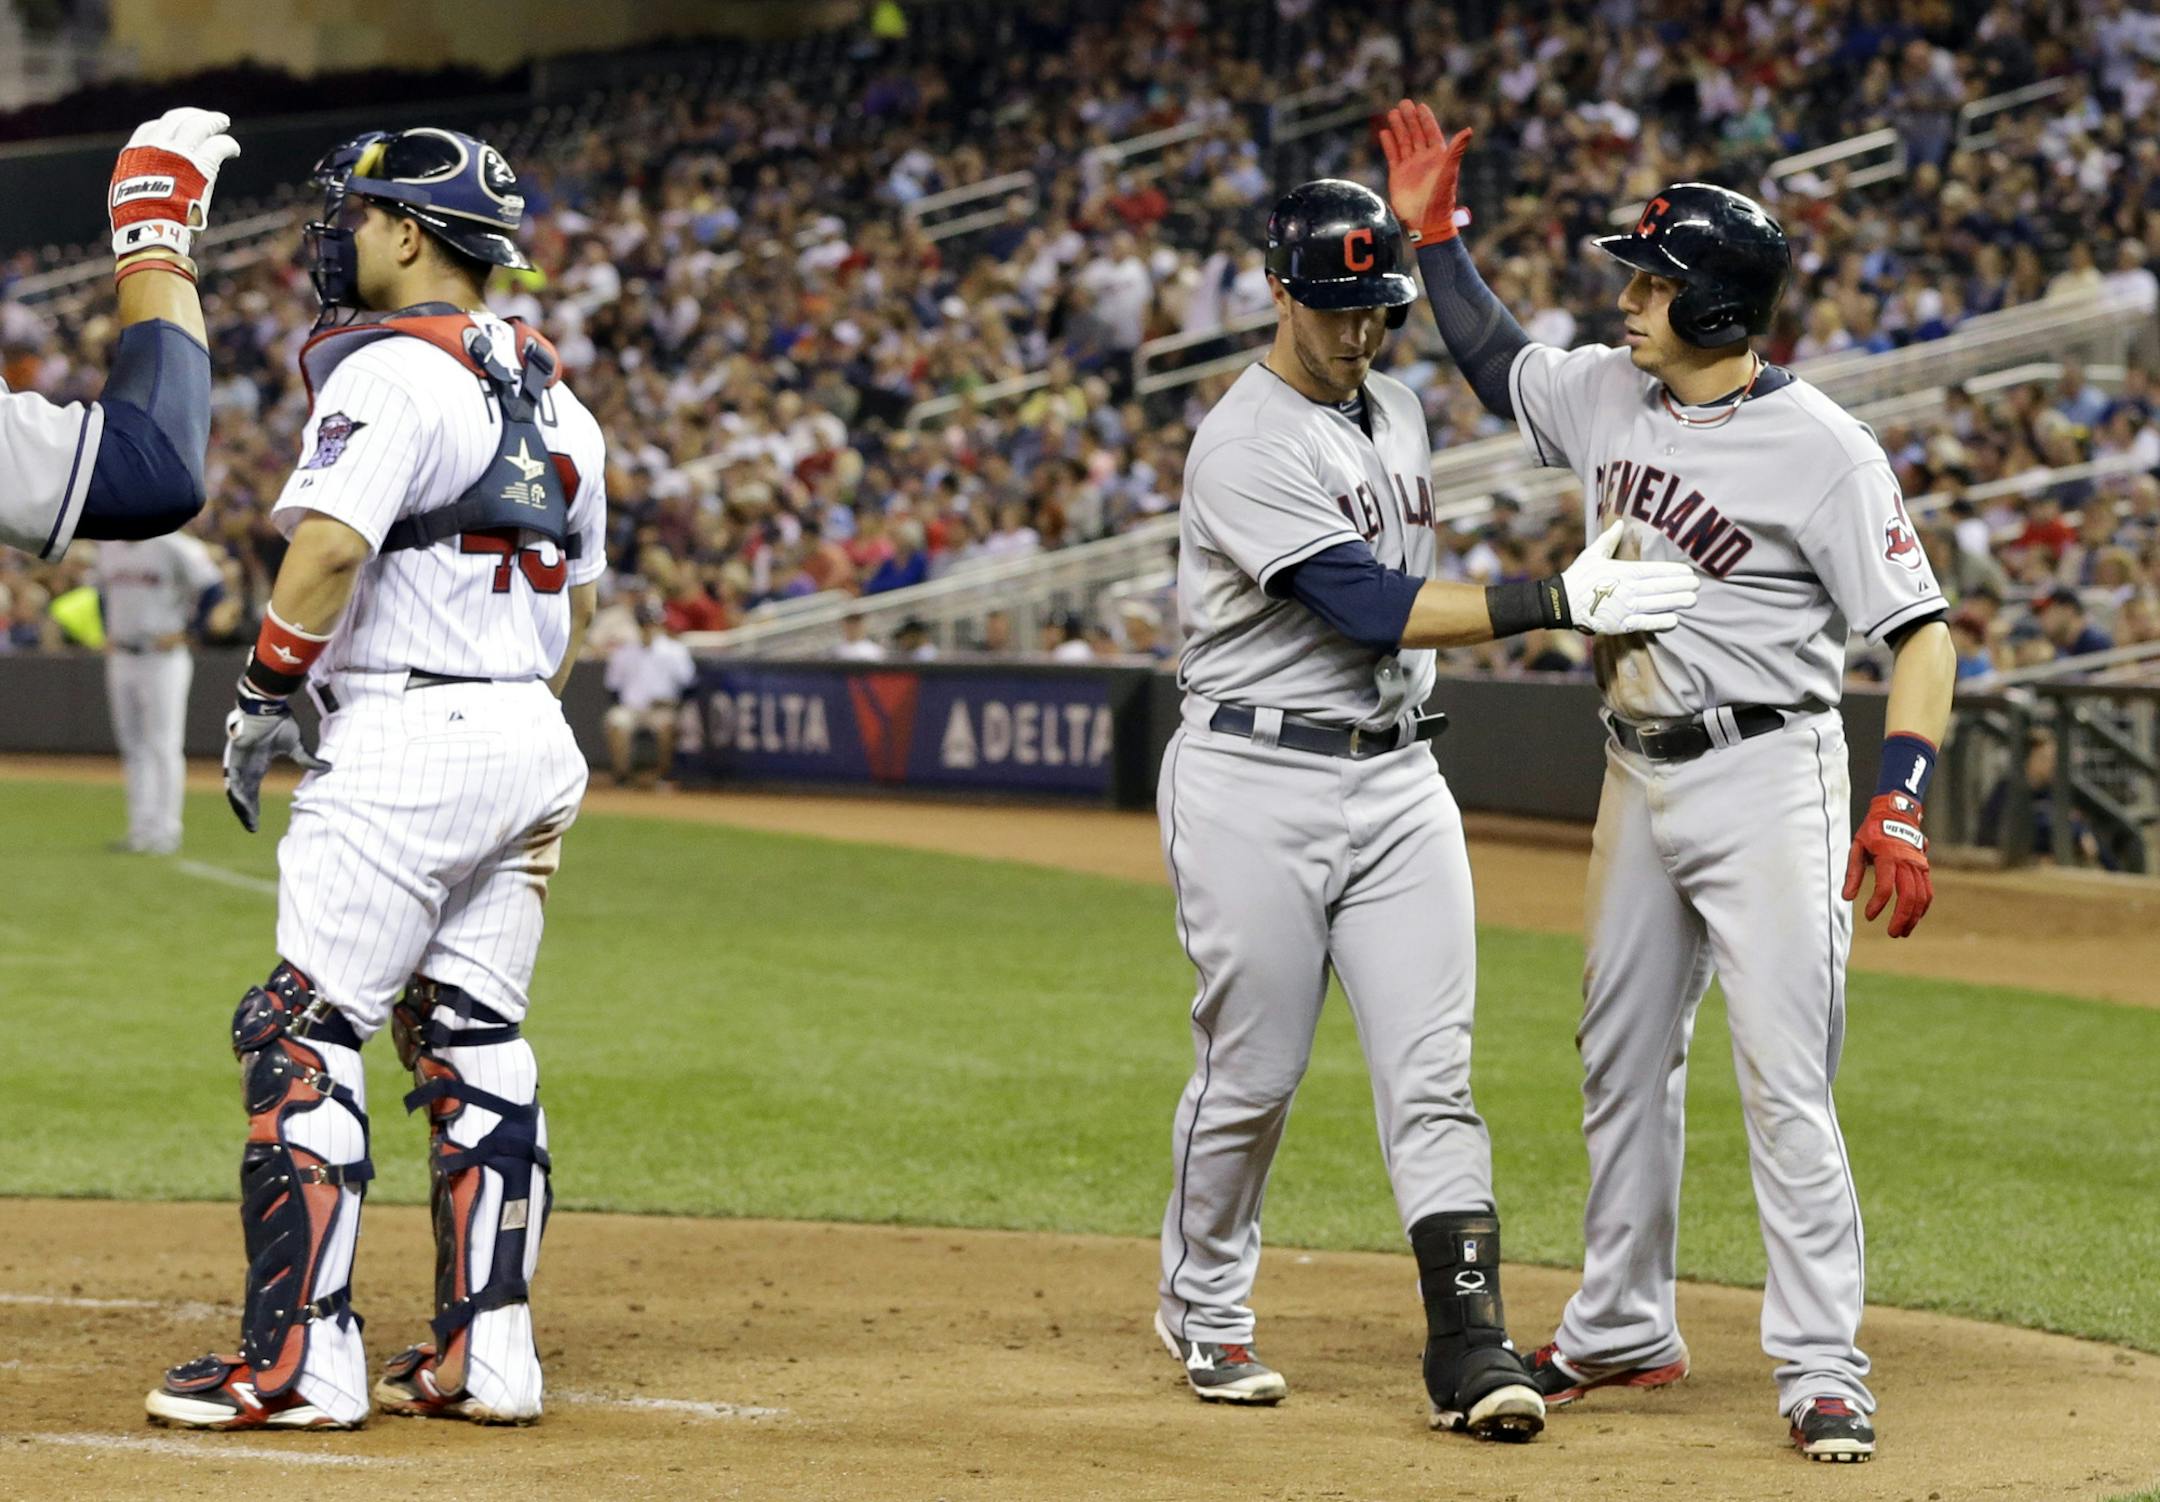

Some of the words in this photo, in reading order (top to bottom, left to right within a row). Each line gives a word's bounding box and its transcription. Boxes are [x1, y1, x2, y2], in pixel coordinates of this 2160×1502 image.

[1635, 197, 1671, 235] C
[1344, 228, 1374, 272] C
[1597, 460, 1753, 580] EVELAND
[708, 691, 831, 753] DELTA
[982, 702, 1114, 766] DELTA
